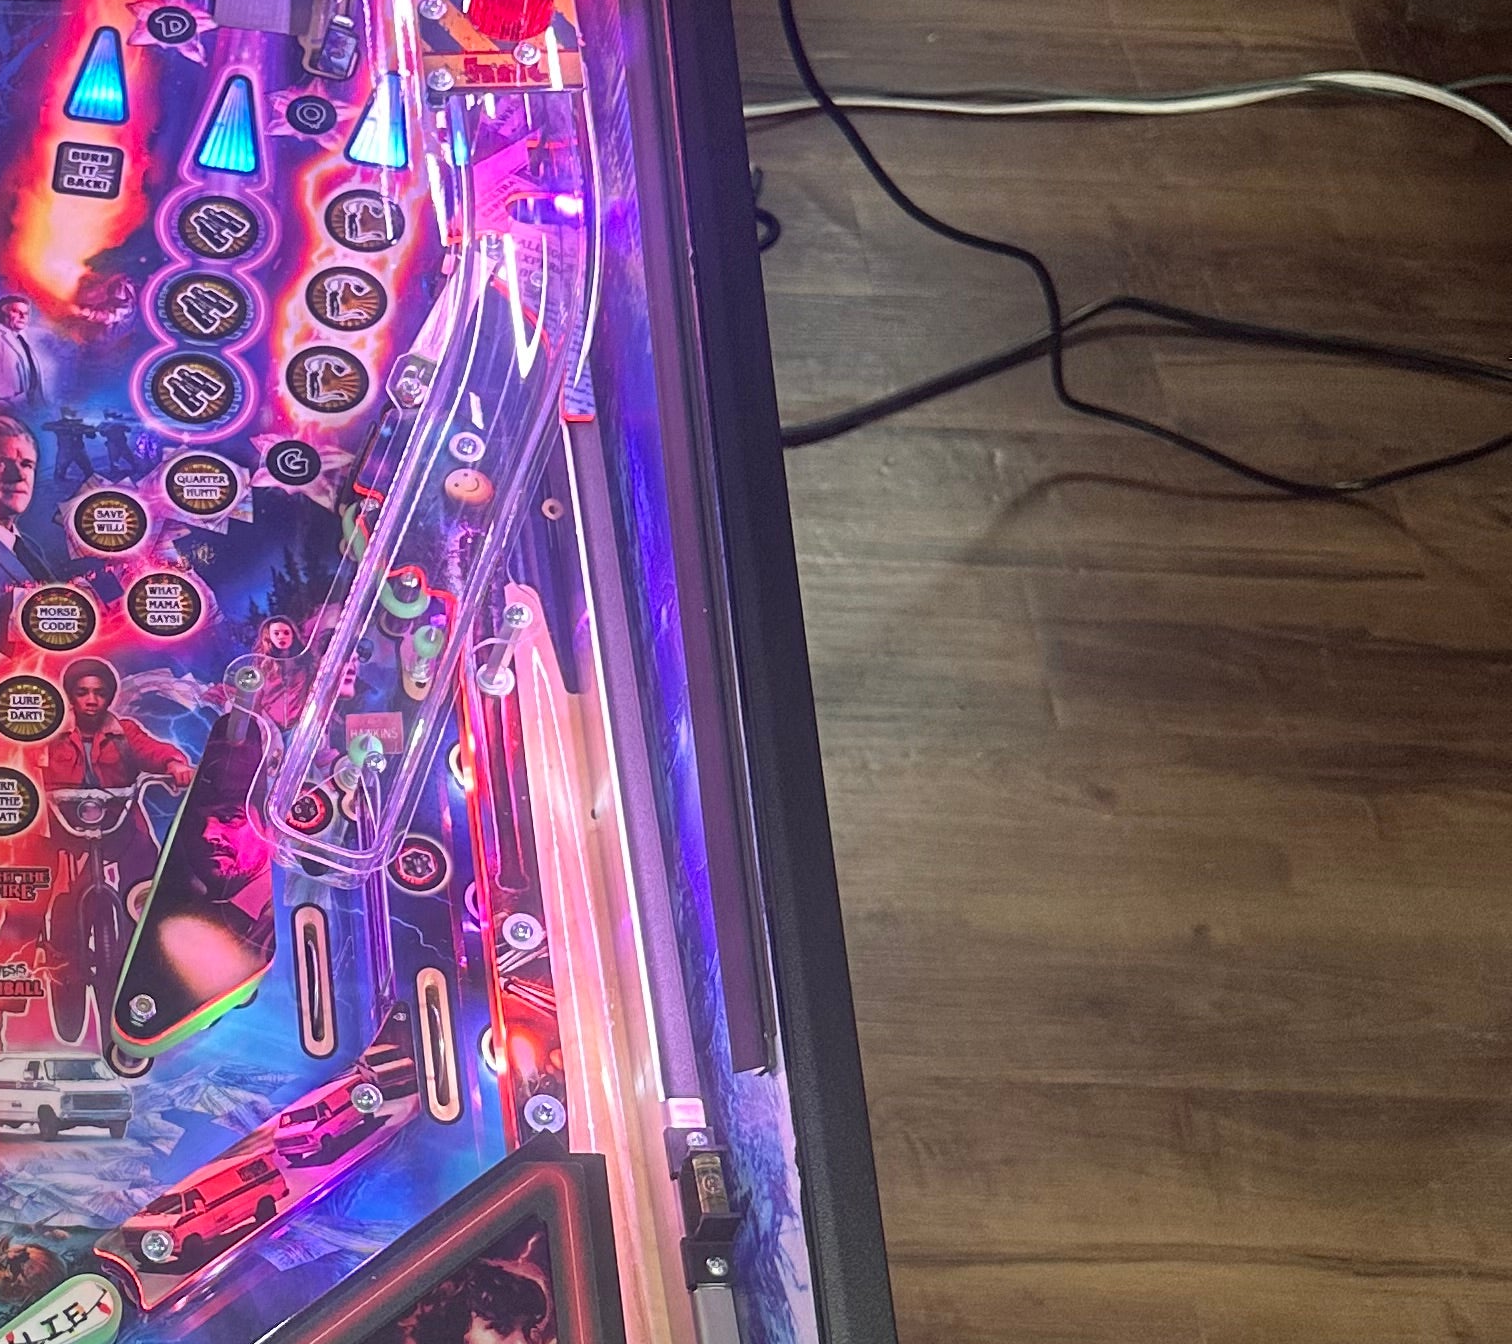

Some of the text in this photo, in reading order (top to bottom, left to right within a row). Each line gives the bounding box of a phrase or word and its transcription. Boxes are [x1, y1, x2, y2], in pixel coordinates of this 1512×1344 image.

[157, 11, 190, 38] D
[68, 149, 112, 165] BURN
[80, 164, 98, 177] IT
[65, 176, 111, 192] BACK!
[276, 448, 310, 477] G
[175, 473, 227, 486] QUARTER
[183, 485, 219, 499] HUNT!
[94, 507, 126, 520] SAVE
[94, 520, 126, 534] WILL!
[148, 584, 181, 598] WHAT
[146, 597, 183, 612] MAMA
[38, 606, 81, 620] MORSE
[147, 612, 184, 626] SAYS!
[39, 619, 80, 633] CODE!
[10, 695, 43, 708] LURE
[6, 709, 45, 723] DART!
[18, 868, 50, 885] THE
